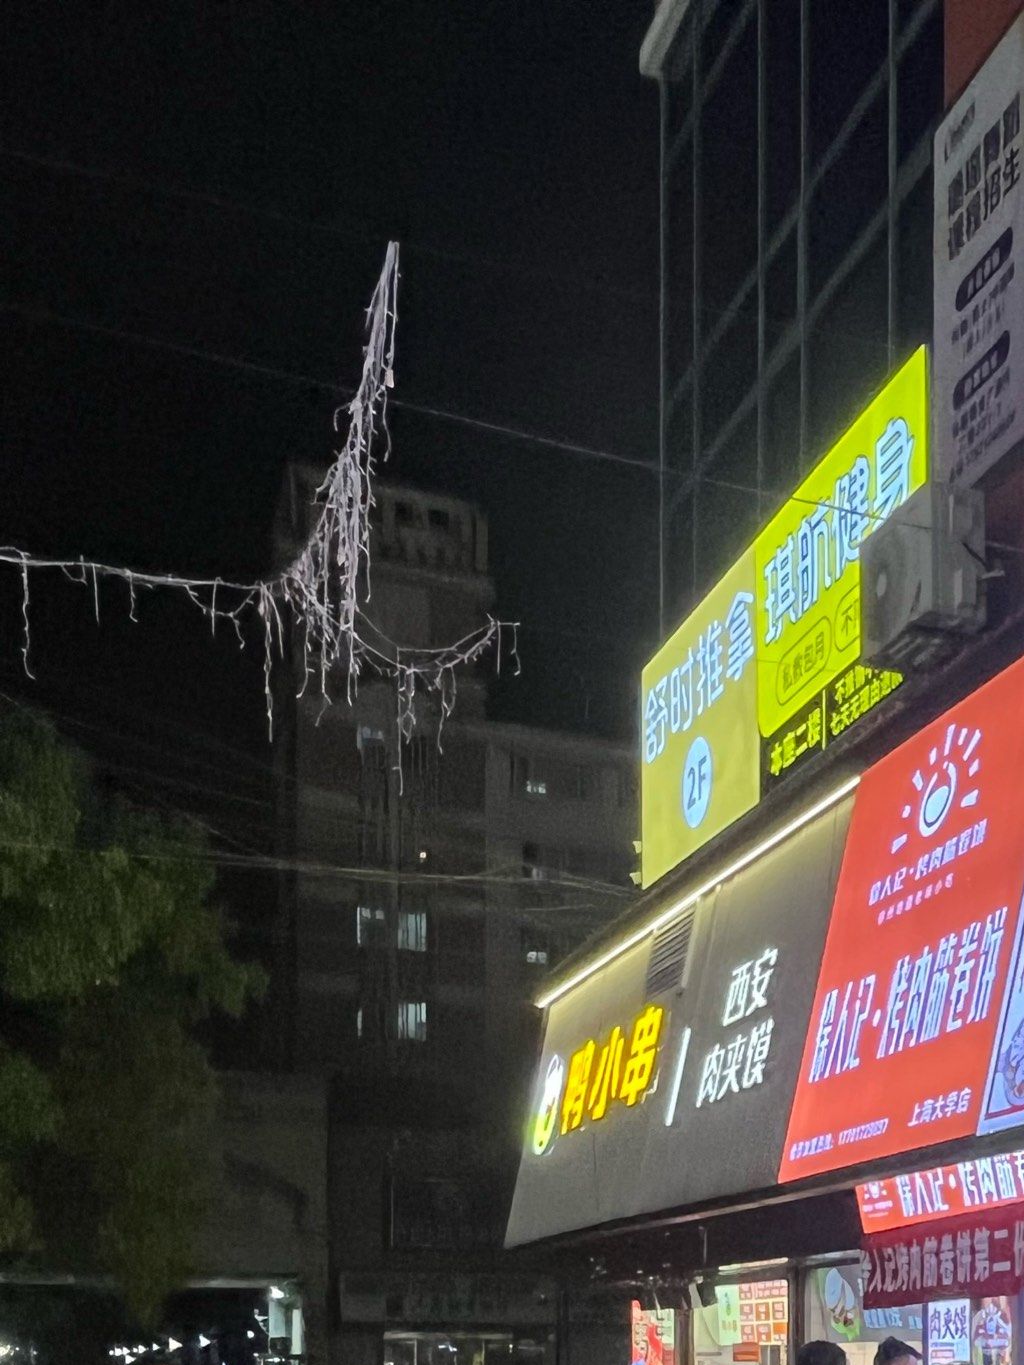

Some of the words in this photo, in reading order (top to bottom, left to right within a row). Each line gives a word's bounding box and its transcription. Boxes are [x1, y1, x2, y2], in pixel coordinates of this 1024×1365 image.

[645, 591, 755, 764] 舒时推拿
[687, 755, 708, 810] 2F
[722, 948, 778, 1027] 西安
[696, 1016, 775, 1108] 肉夹馍
[907, 1087, 972, 1127] 上海大学店
[930, 1305, 968, 1340] 肉夹馍
